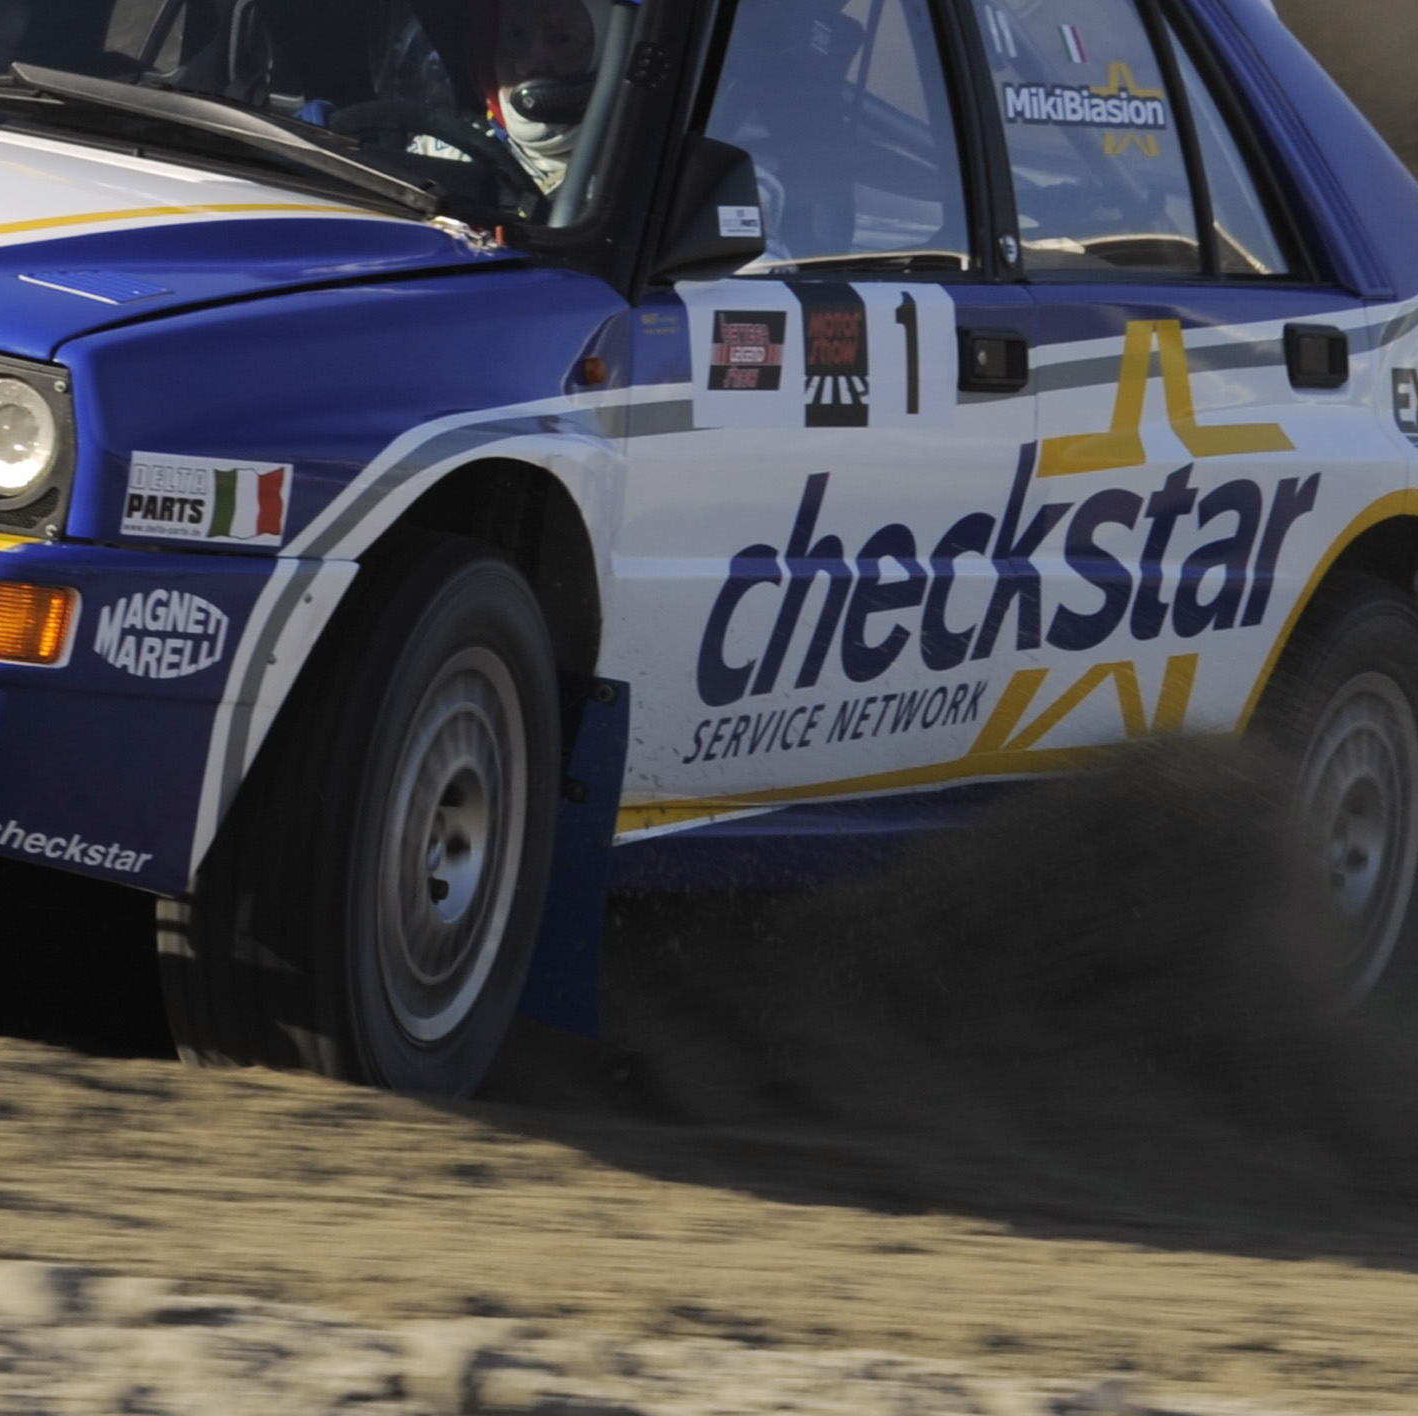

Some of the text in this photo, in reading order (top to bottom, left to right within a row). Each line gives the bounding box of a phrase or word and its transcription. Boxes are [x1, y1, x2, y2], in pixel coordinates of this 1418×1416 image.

[1005, 86, 1166, 126] MikiBiasion
[895, 291, 919, 414] 1
[130, 463, 207, 495] DELTA
[126, 493, 206, 525] PARTS
[697, 440, 1321, 707] checkstar
[93, 588, 229, 640] MAGNETI
[93, 626, 224, 679] MARELLI
[682, 681, 988, 765] SERVICE NETWORK
